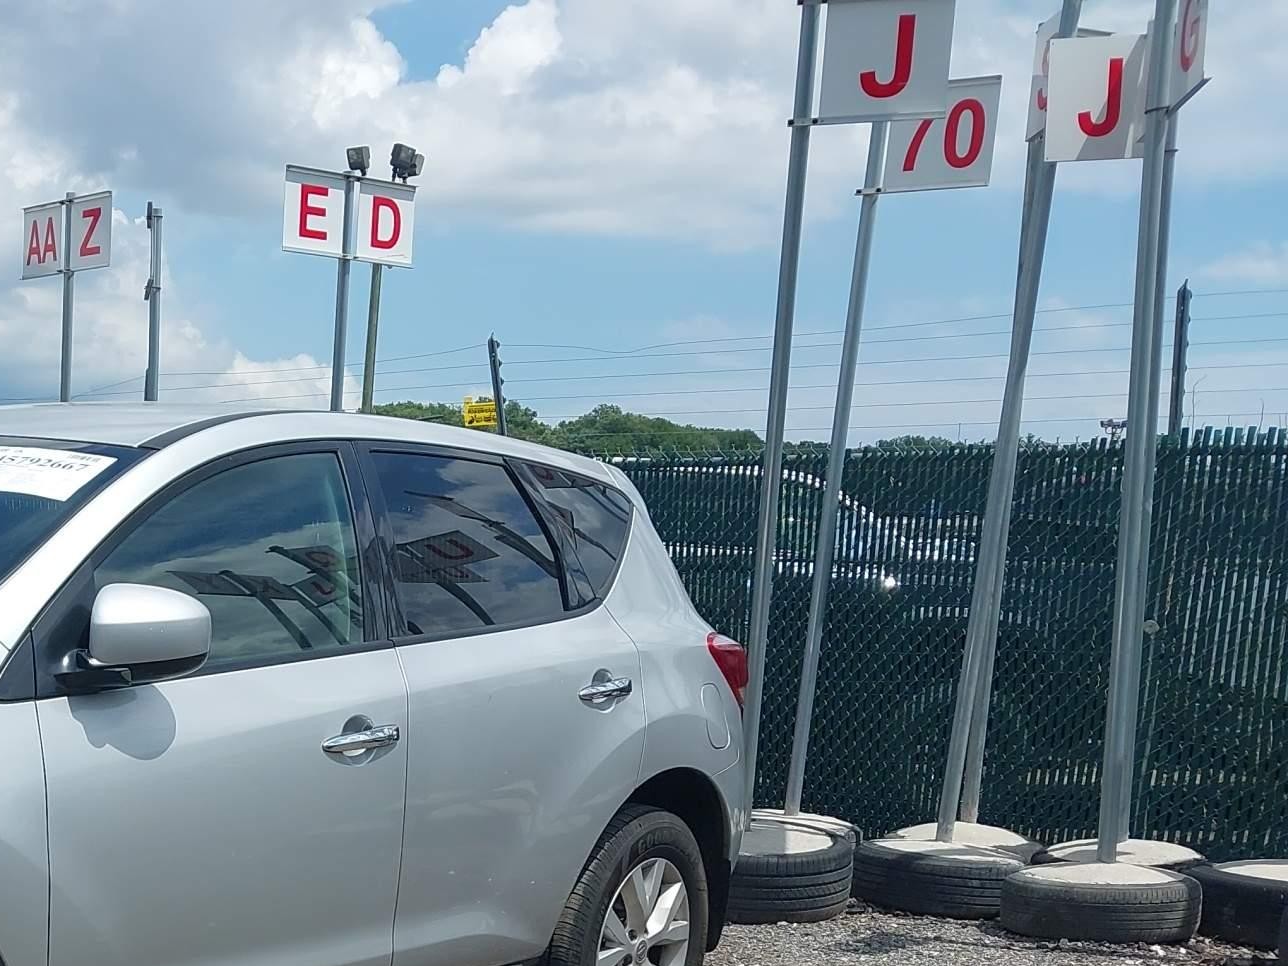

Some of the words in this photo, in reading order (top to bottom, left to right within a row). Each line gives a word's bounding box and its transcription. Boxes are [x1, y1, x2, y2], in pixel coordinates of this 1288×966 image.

[859, 14, 916, 99] J
[1077, 57, 1124, 138] J
[79, 207, 102, 257] Z
[298, 183, 329, 241] E
[370, 196, 401, 249] D
[27, 216, 58, 266] AA
